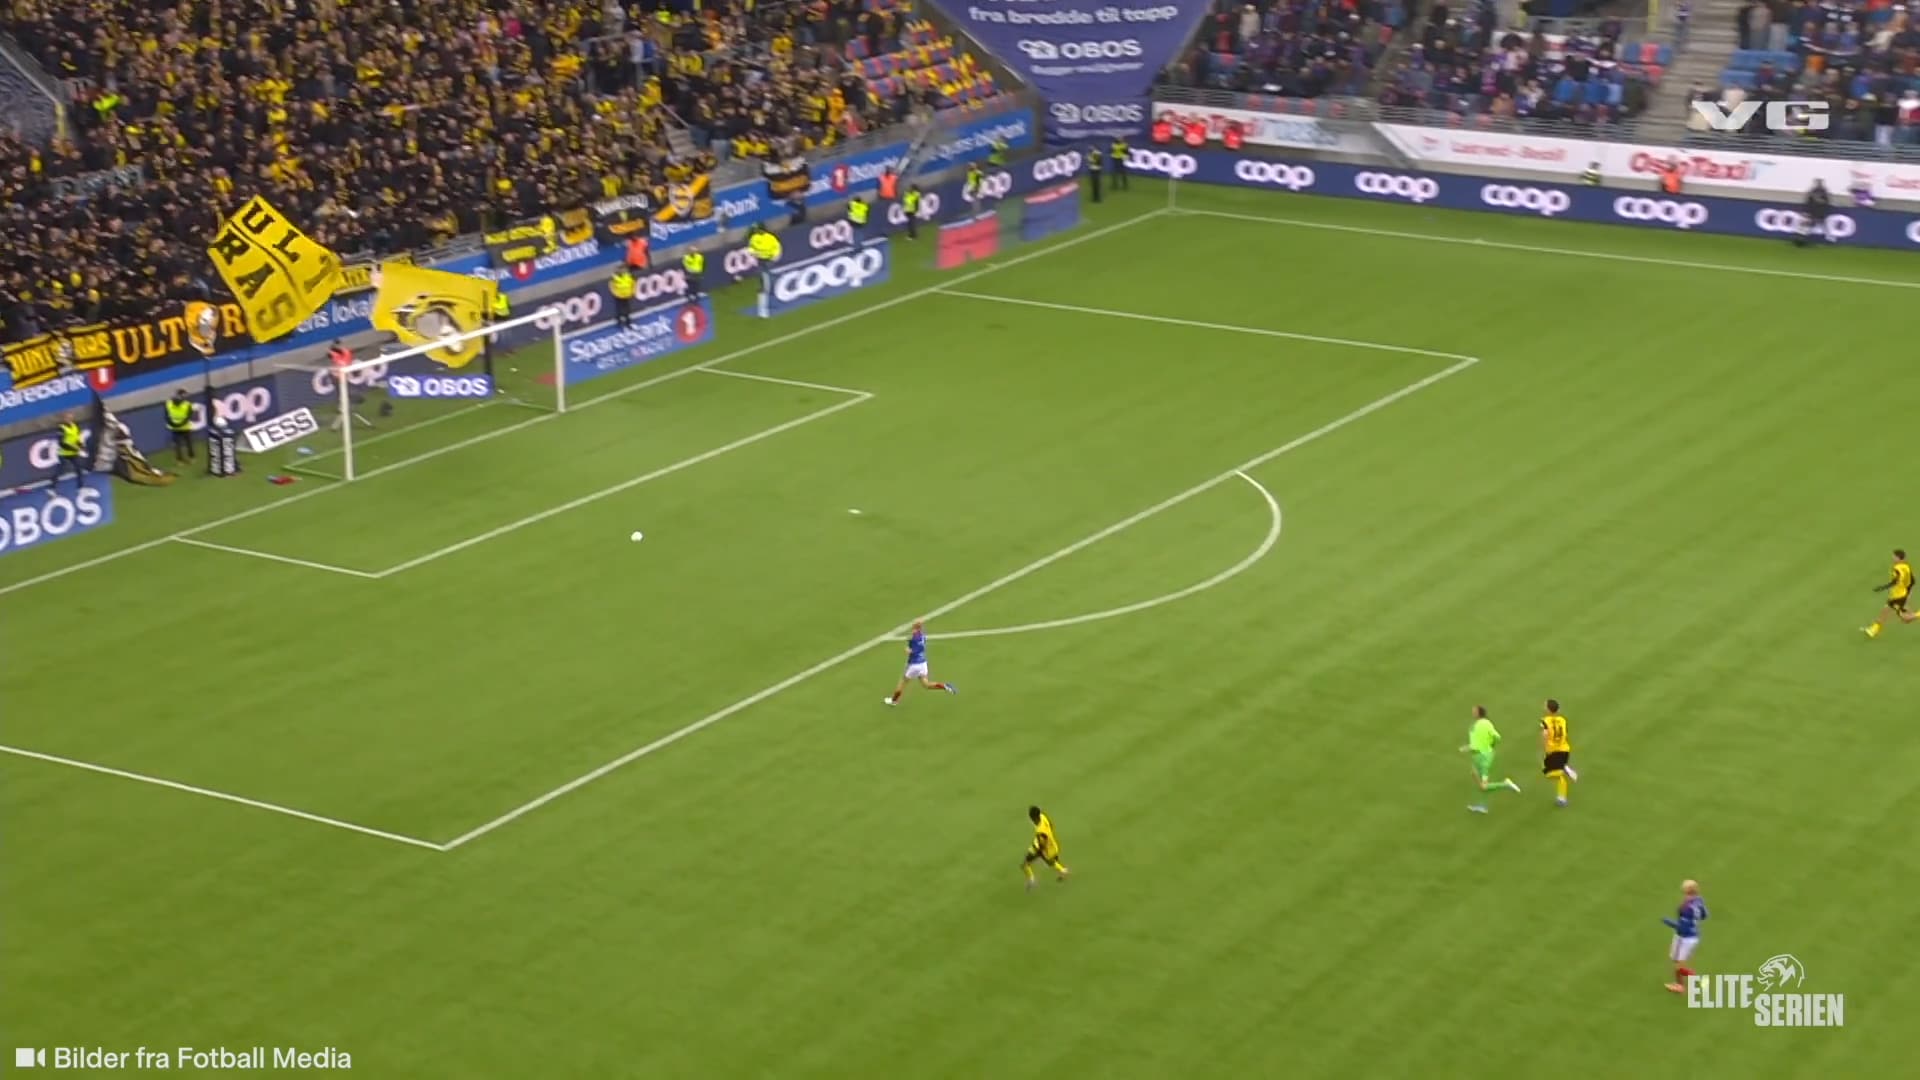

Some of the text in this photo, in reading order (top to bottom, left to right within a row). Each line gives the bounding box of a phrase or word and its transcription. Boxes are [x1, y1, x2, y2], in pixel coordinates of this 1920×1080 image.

[967, 6, 1006, 23] fra
[1007, 9, 1093, 25] bredde
[1061, 39, 1143, 59] OBOS
[1033, 151, 1082, 181] coop
[1235, 160, 1315, 190] coop
[1355, 172, 1440, 202] coop
[1480, 184, 1571, 216] coop
[1614, 196, 1708, 228] coop
[775, 247, 884, 302] coop
[249, 409, 313, 447] TESS
